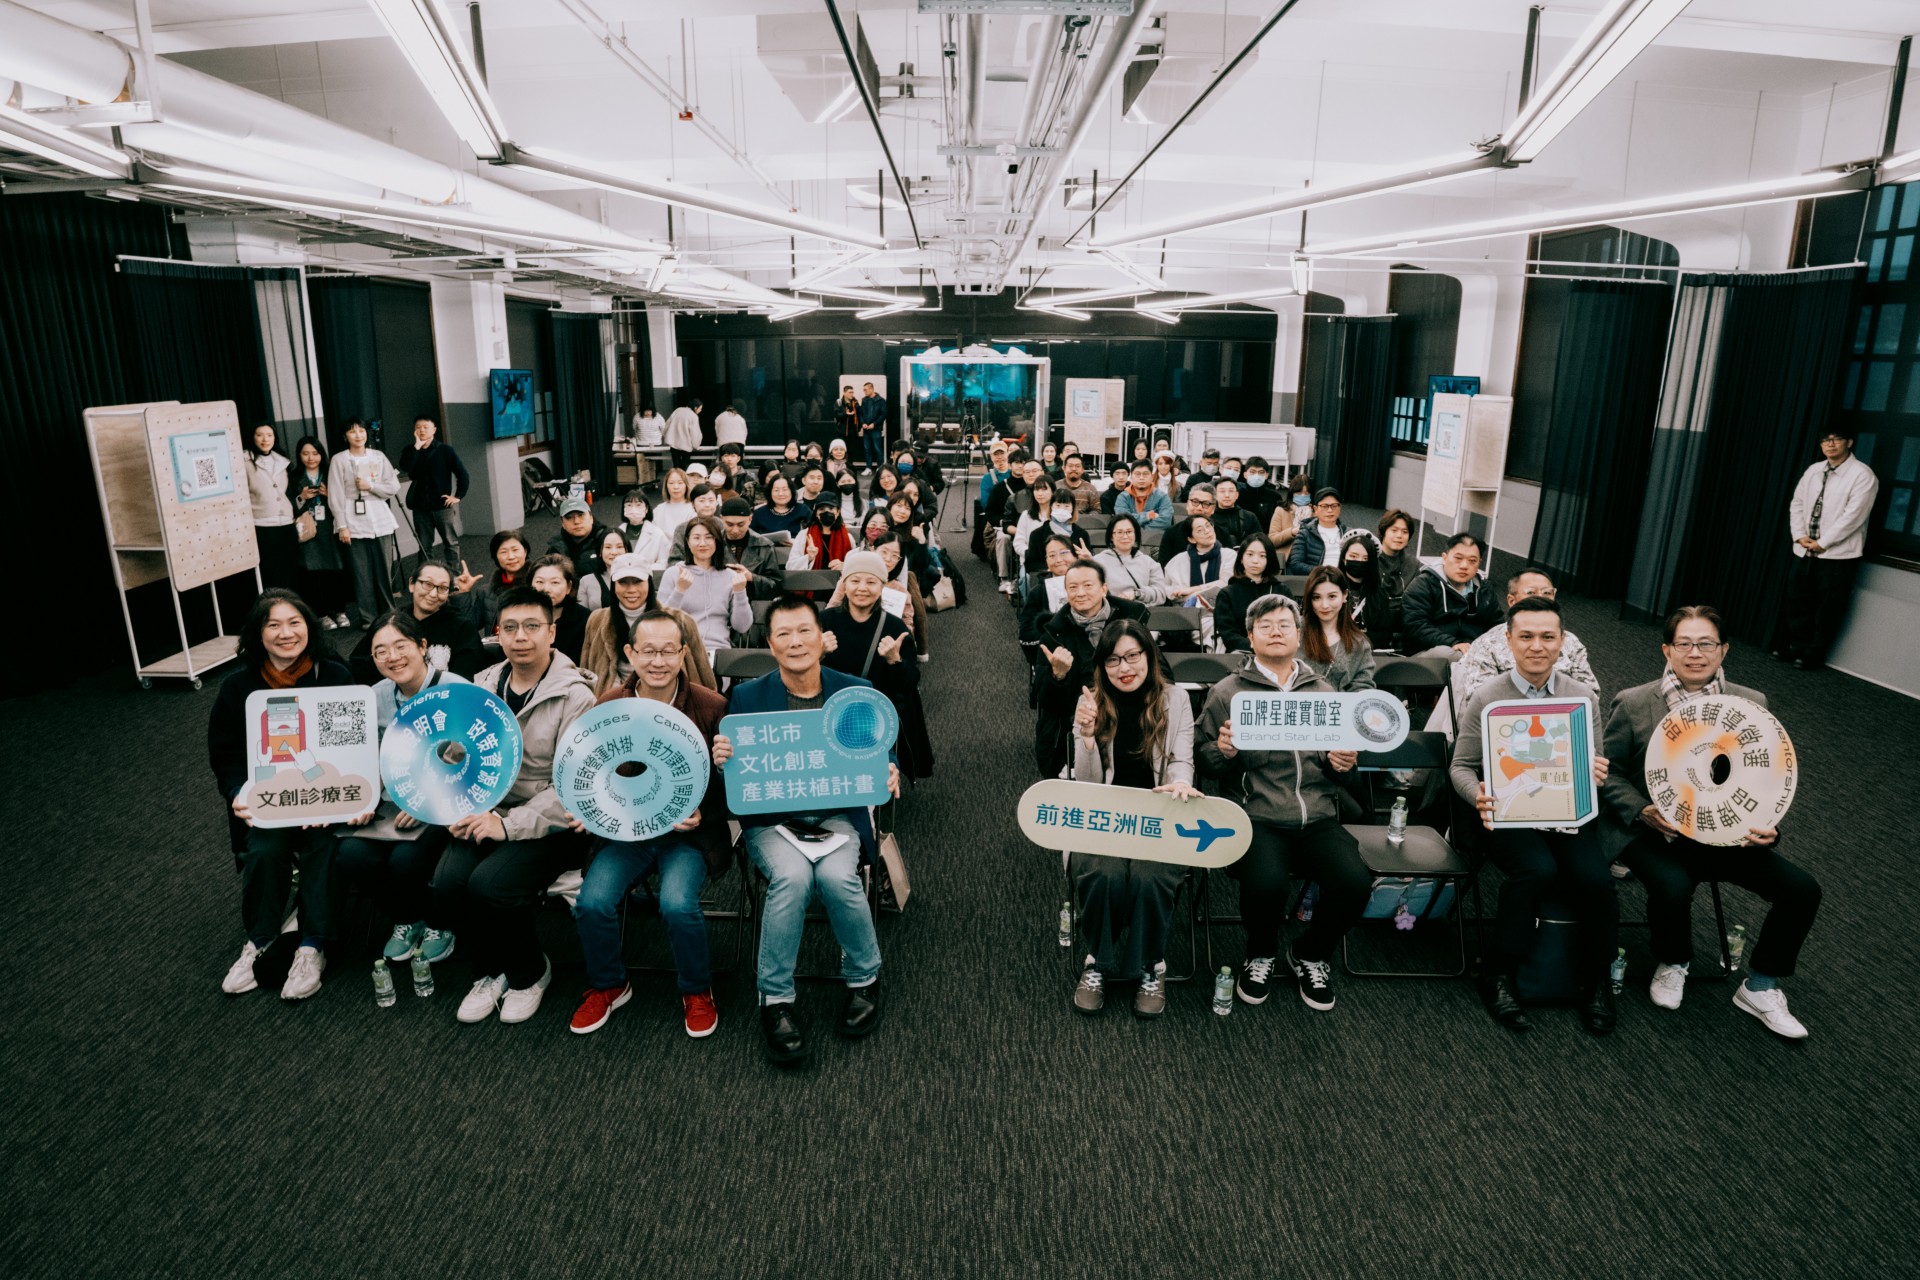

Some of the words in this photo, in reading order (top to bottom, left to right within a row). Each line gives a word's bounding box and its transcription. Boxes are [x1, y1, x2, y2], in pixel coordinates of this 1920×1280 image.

[400, 689, 450, 716] Briefing
[484, 698, 514, 733] Policy
[1240, 699, 1342, 726] 品牌星躍實驗室
[573, 714, 631, 744] Courses
[735, 722, 802, 746] 臺北市
[1240, 732, 1280, 741] Brand
[1284, 732, 1311, 741] Star
[1314, 732, 1341, 741] Lab
[1662, 702, 1770, 768] 品牌輔導徵選
[573, 735, 634, 791] 開啟營運外掛
[646, 737, 692, 778] 培力課程
[738, 749, 828, 775] 文化創意
[1768, 717, 1793, 814] Mentorship
[257, 784, 362, 809] 文創診療室
[742, 773, 876, 802] 產業扶植計畫
[576, 798, 622, 835] 培力課程
[1035, 803, 1165, 839] 前進亞洲區
